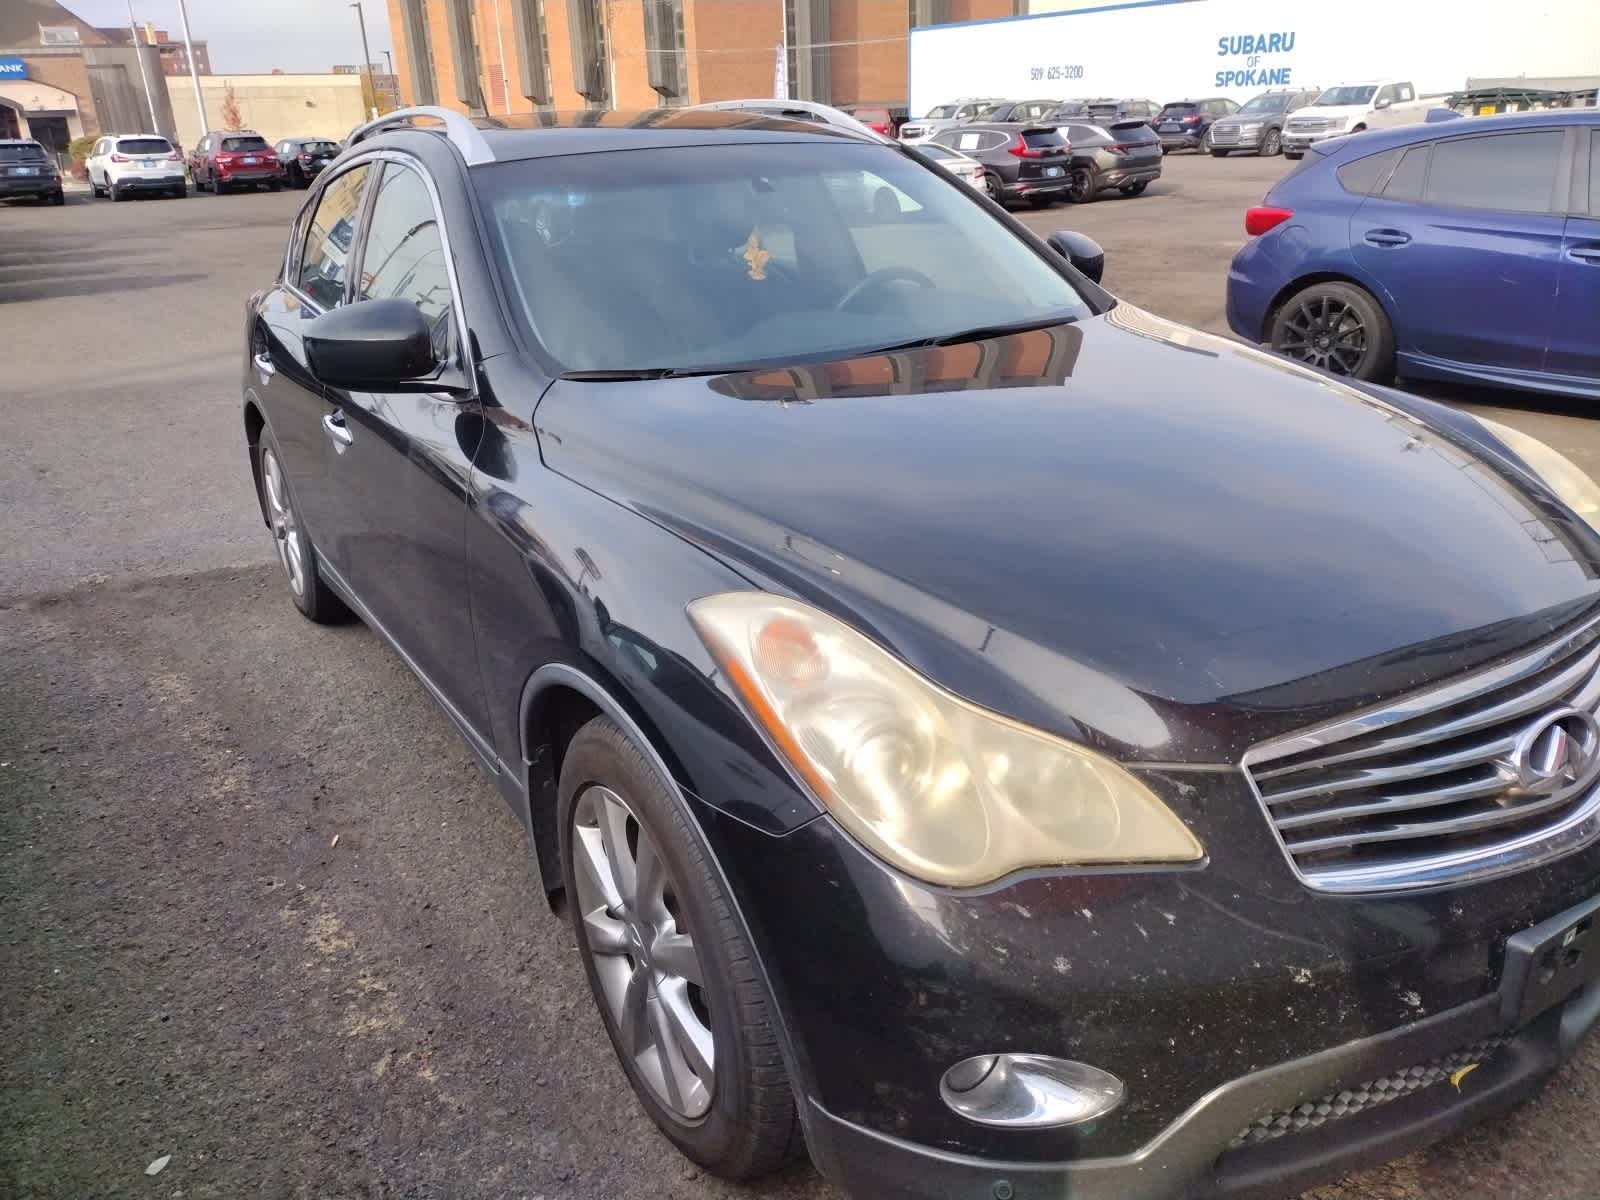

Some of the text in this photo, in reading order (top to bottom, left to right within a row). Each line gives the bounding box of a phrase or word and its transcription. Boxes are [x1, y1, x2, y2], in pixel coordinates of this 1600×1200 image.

[1217, 32, 1295, 56] SUBARU
[1246, 55, 1261, 68] OF
[1030, 65, 1084, 81] 509 625-3200
[1215, 67, 1292, 88] SPOKANE
